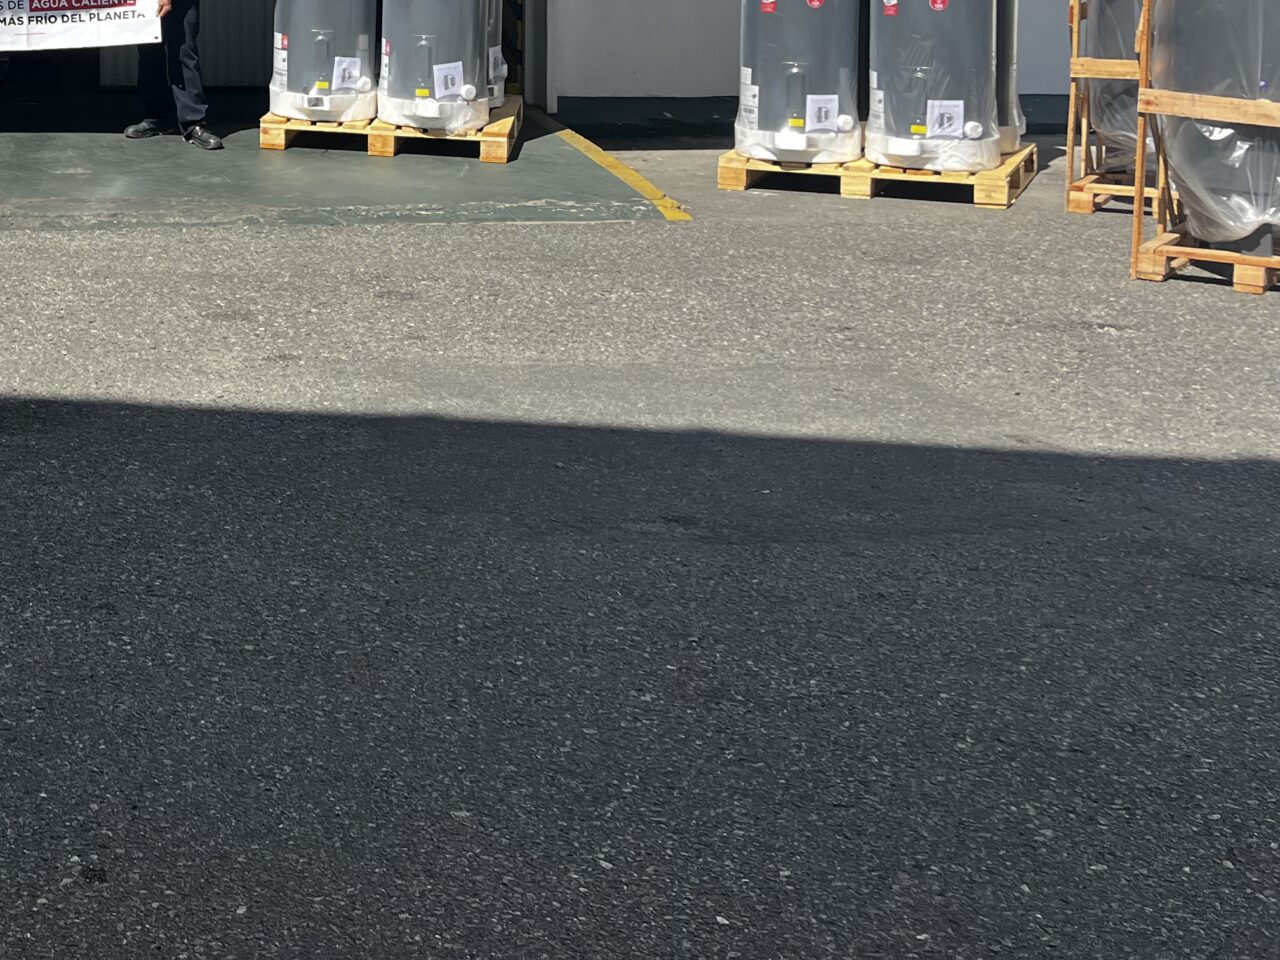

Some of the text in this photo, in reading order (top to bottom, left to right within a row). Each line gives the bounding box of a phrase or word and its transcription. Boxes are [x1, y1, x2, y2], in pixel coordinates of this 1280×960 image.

[8, 0, 25, 10] DE
[28, 13, 57, 25] FRÍO
[61, 13, 86, 23] DEL
[89, 10, 146, 22] PLANETA
